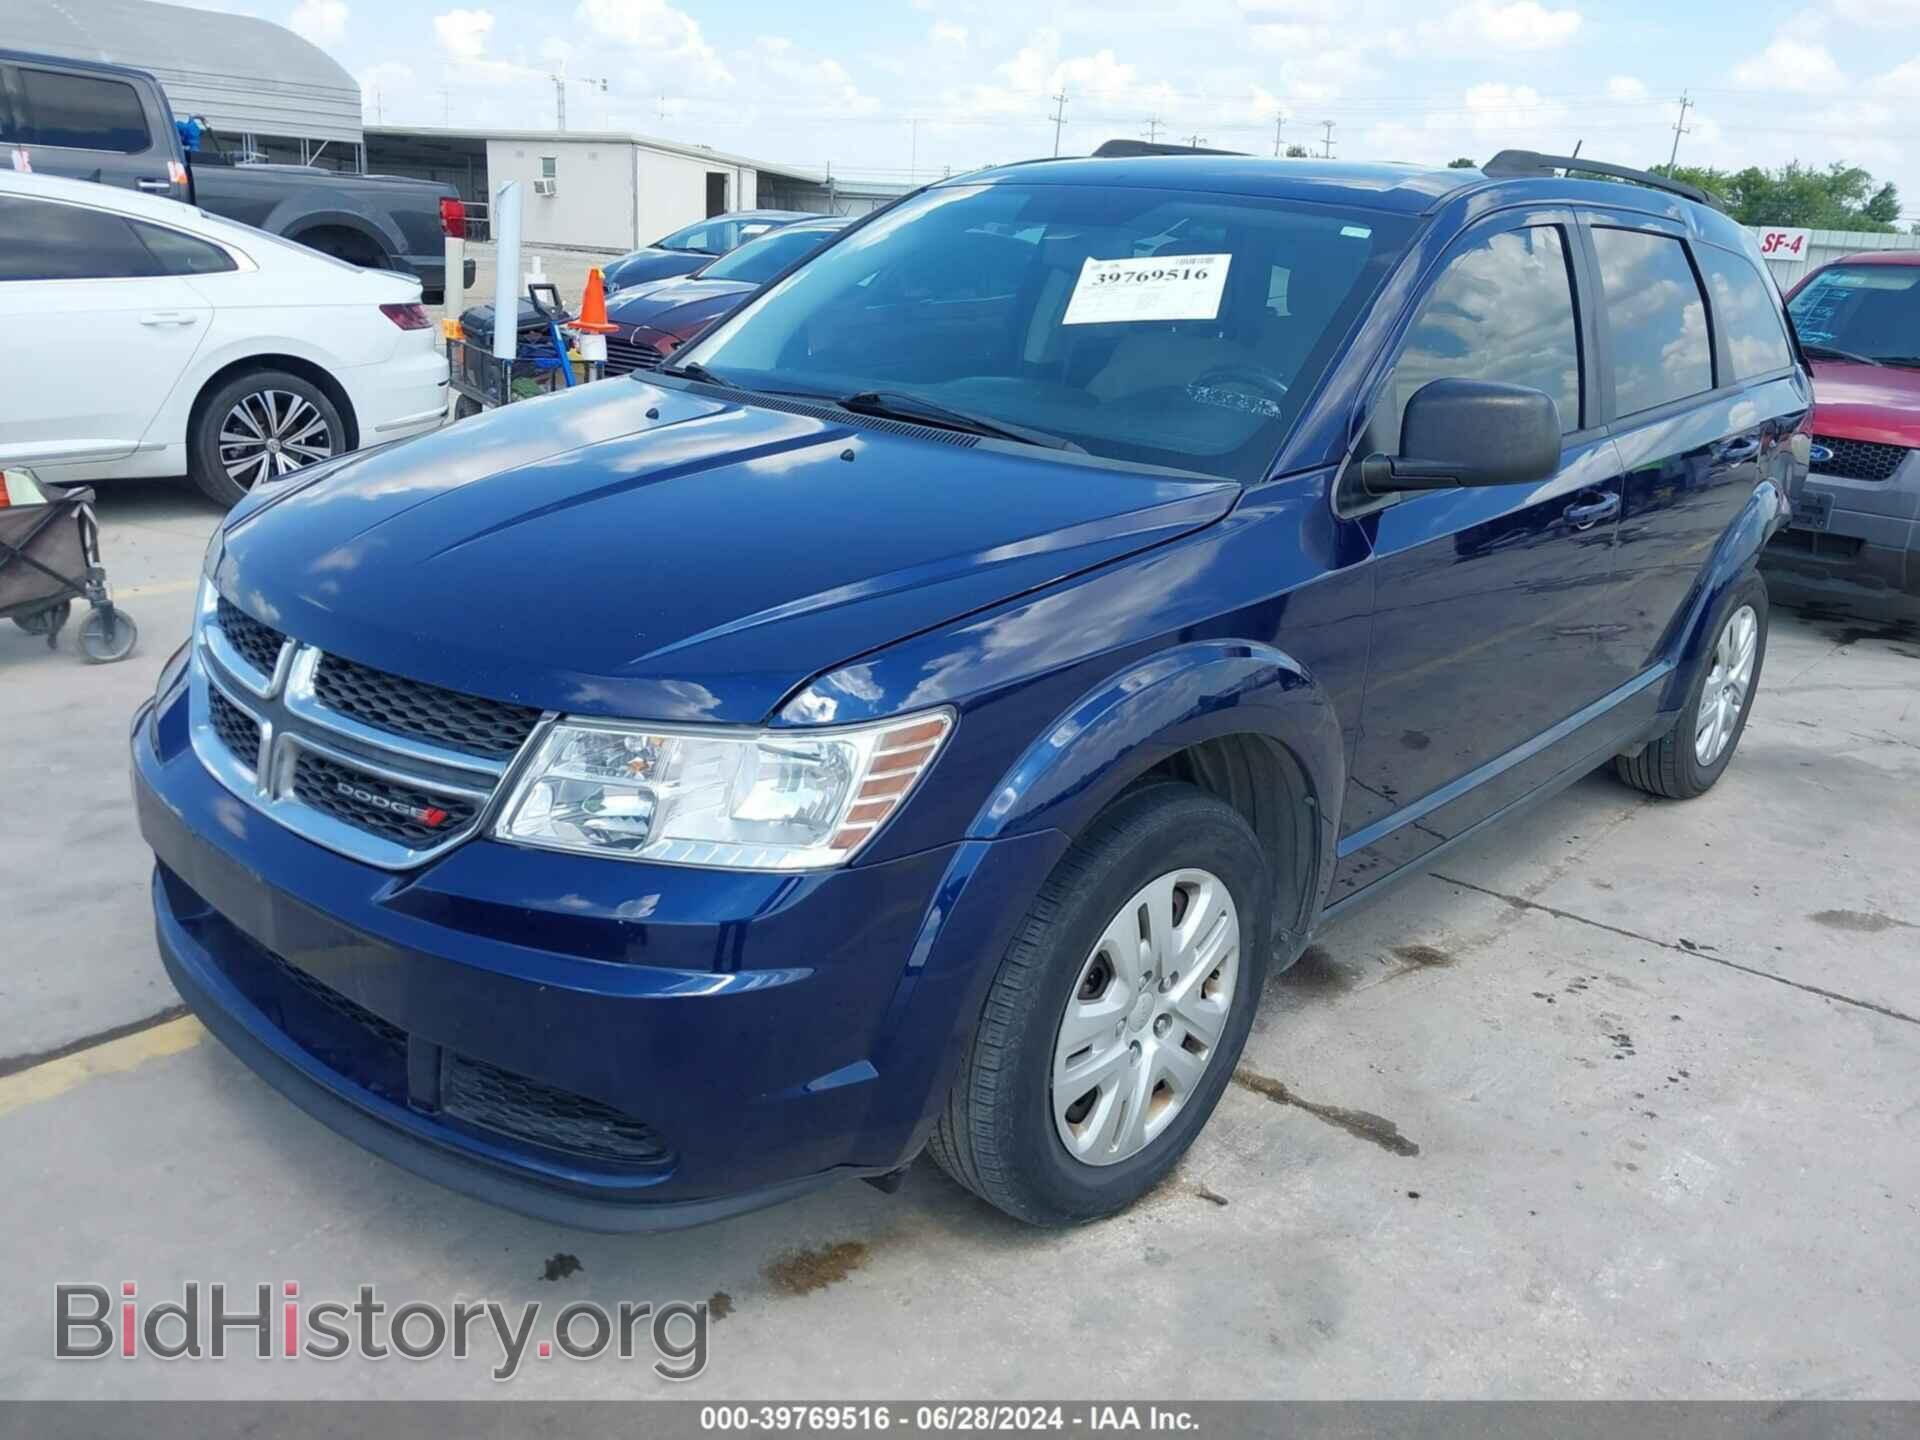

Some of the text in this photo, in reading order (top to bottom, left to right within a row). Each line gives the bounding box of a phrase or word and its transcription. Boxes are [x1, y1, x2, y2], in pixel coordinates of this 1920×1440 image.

[1761, 232, 1803, 254] SF-4
[1092, 268, 1208, 287] 39769516
[337, 782, 427, 819] DODGE
